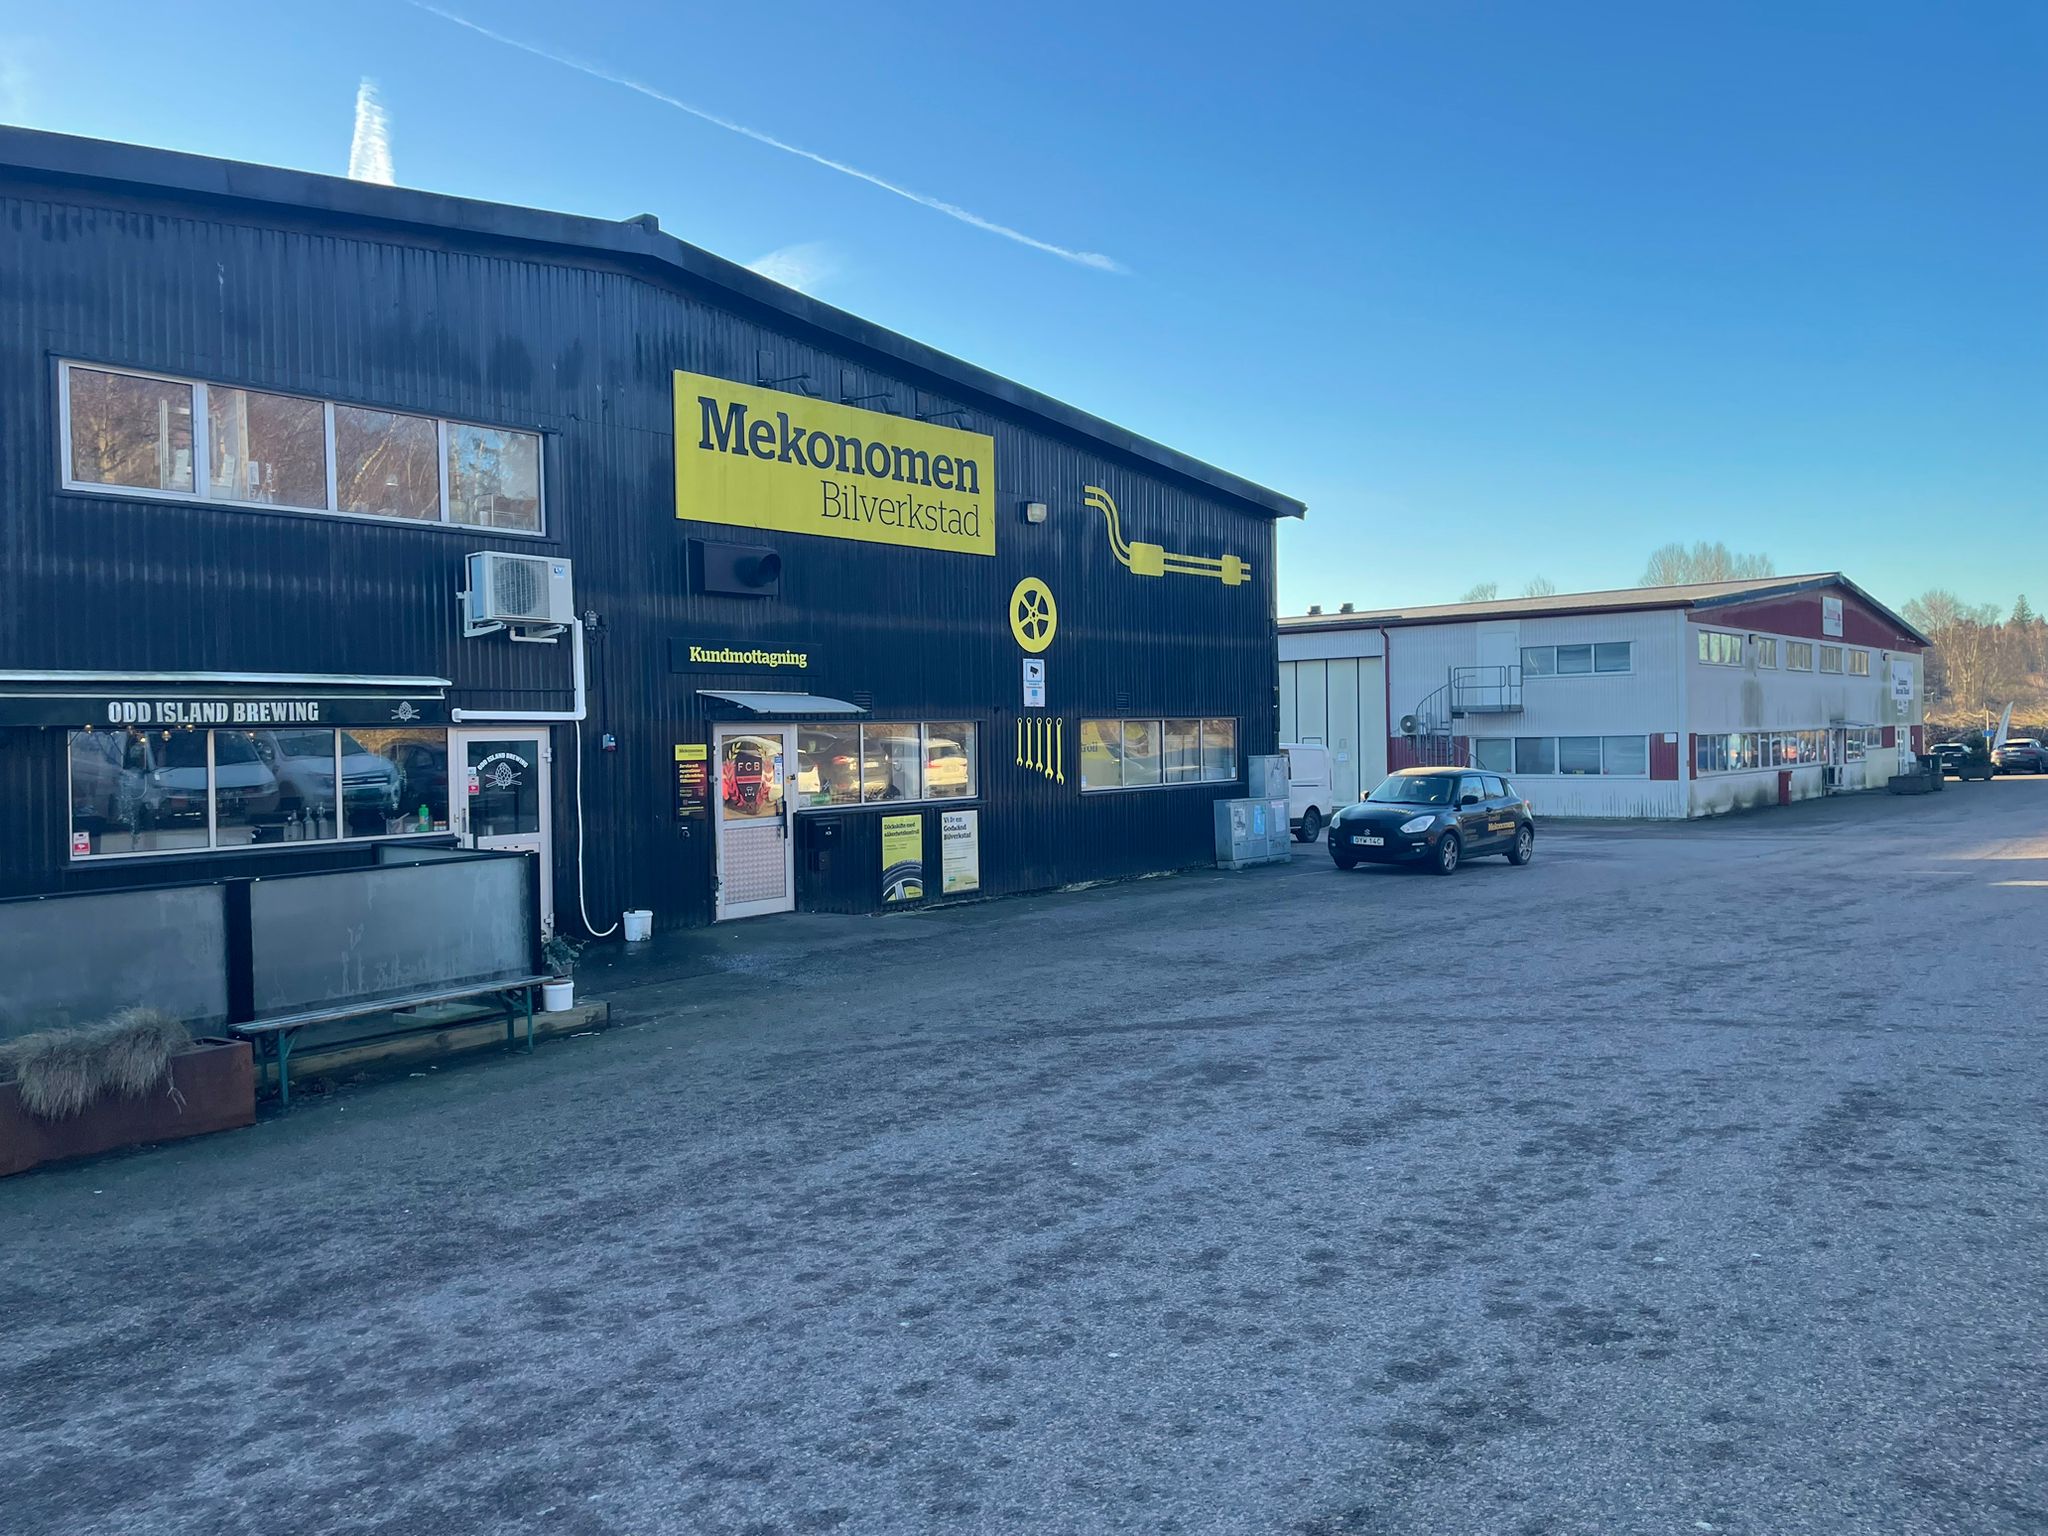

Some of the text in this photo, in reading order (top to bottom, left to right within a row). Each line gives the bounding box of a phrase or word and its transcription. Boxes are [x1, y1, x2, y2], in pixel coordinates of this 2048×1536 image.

[698, 396, 980, 494] Mekonomen
[821, 480, 981, 537] Bilverkstad
[689, 646, 807, 668] Kundmottagning
[108, 701, 319, 723] ODD ISLAND BREWING
[486, 752, 505, 763] ISLAND
[505, 752, 529, 768] BREWING
